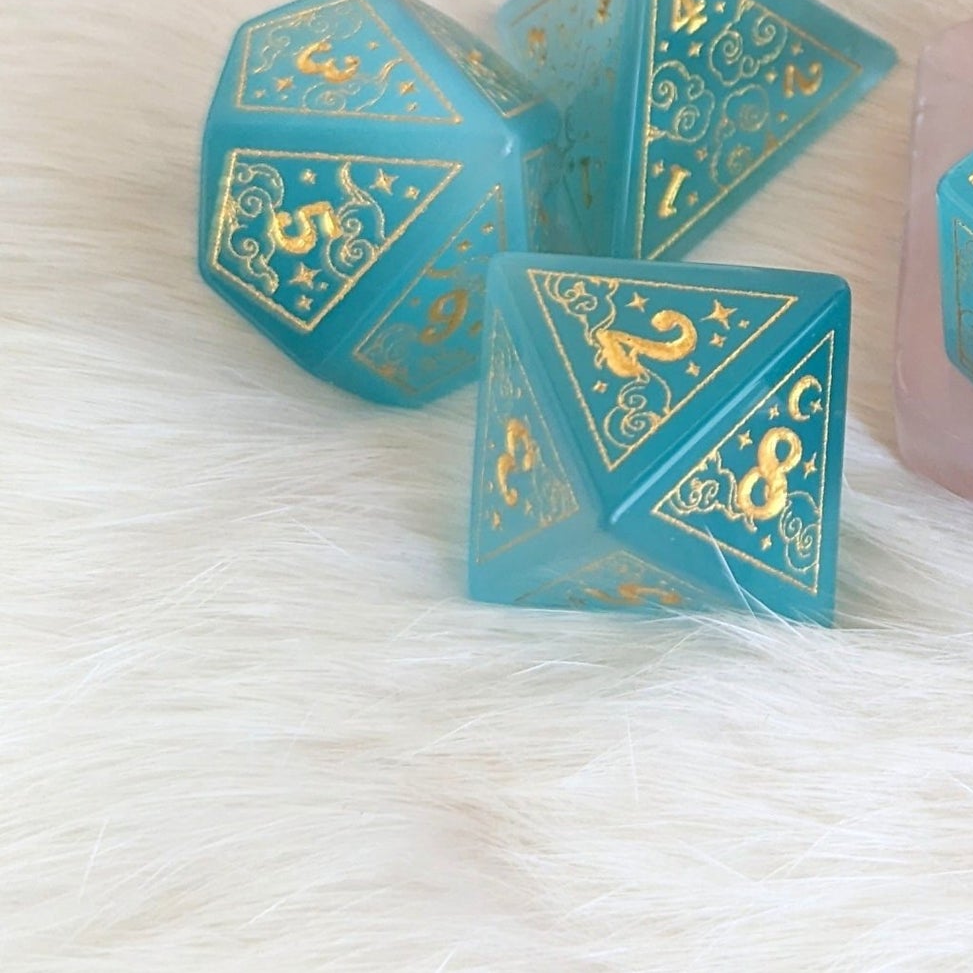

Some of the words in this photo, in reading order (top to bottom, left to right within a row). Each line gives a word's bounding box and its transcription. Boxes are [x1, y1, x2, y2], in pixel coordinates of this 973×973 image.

[298, 41, 360, 83] 3
[783, 62, 823, 98] 2
[658, 165, 692, 218] 1
[272, 201, 342, 254] 5
[597, 310, 698, 378] 2
[737, 426, 803, 520] 8
